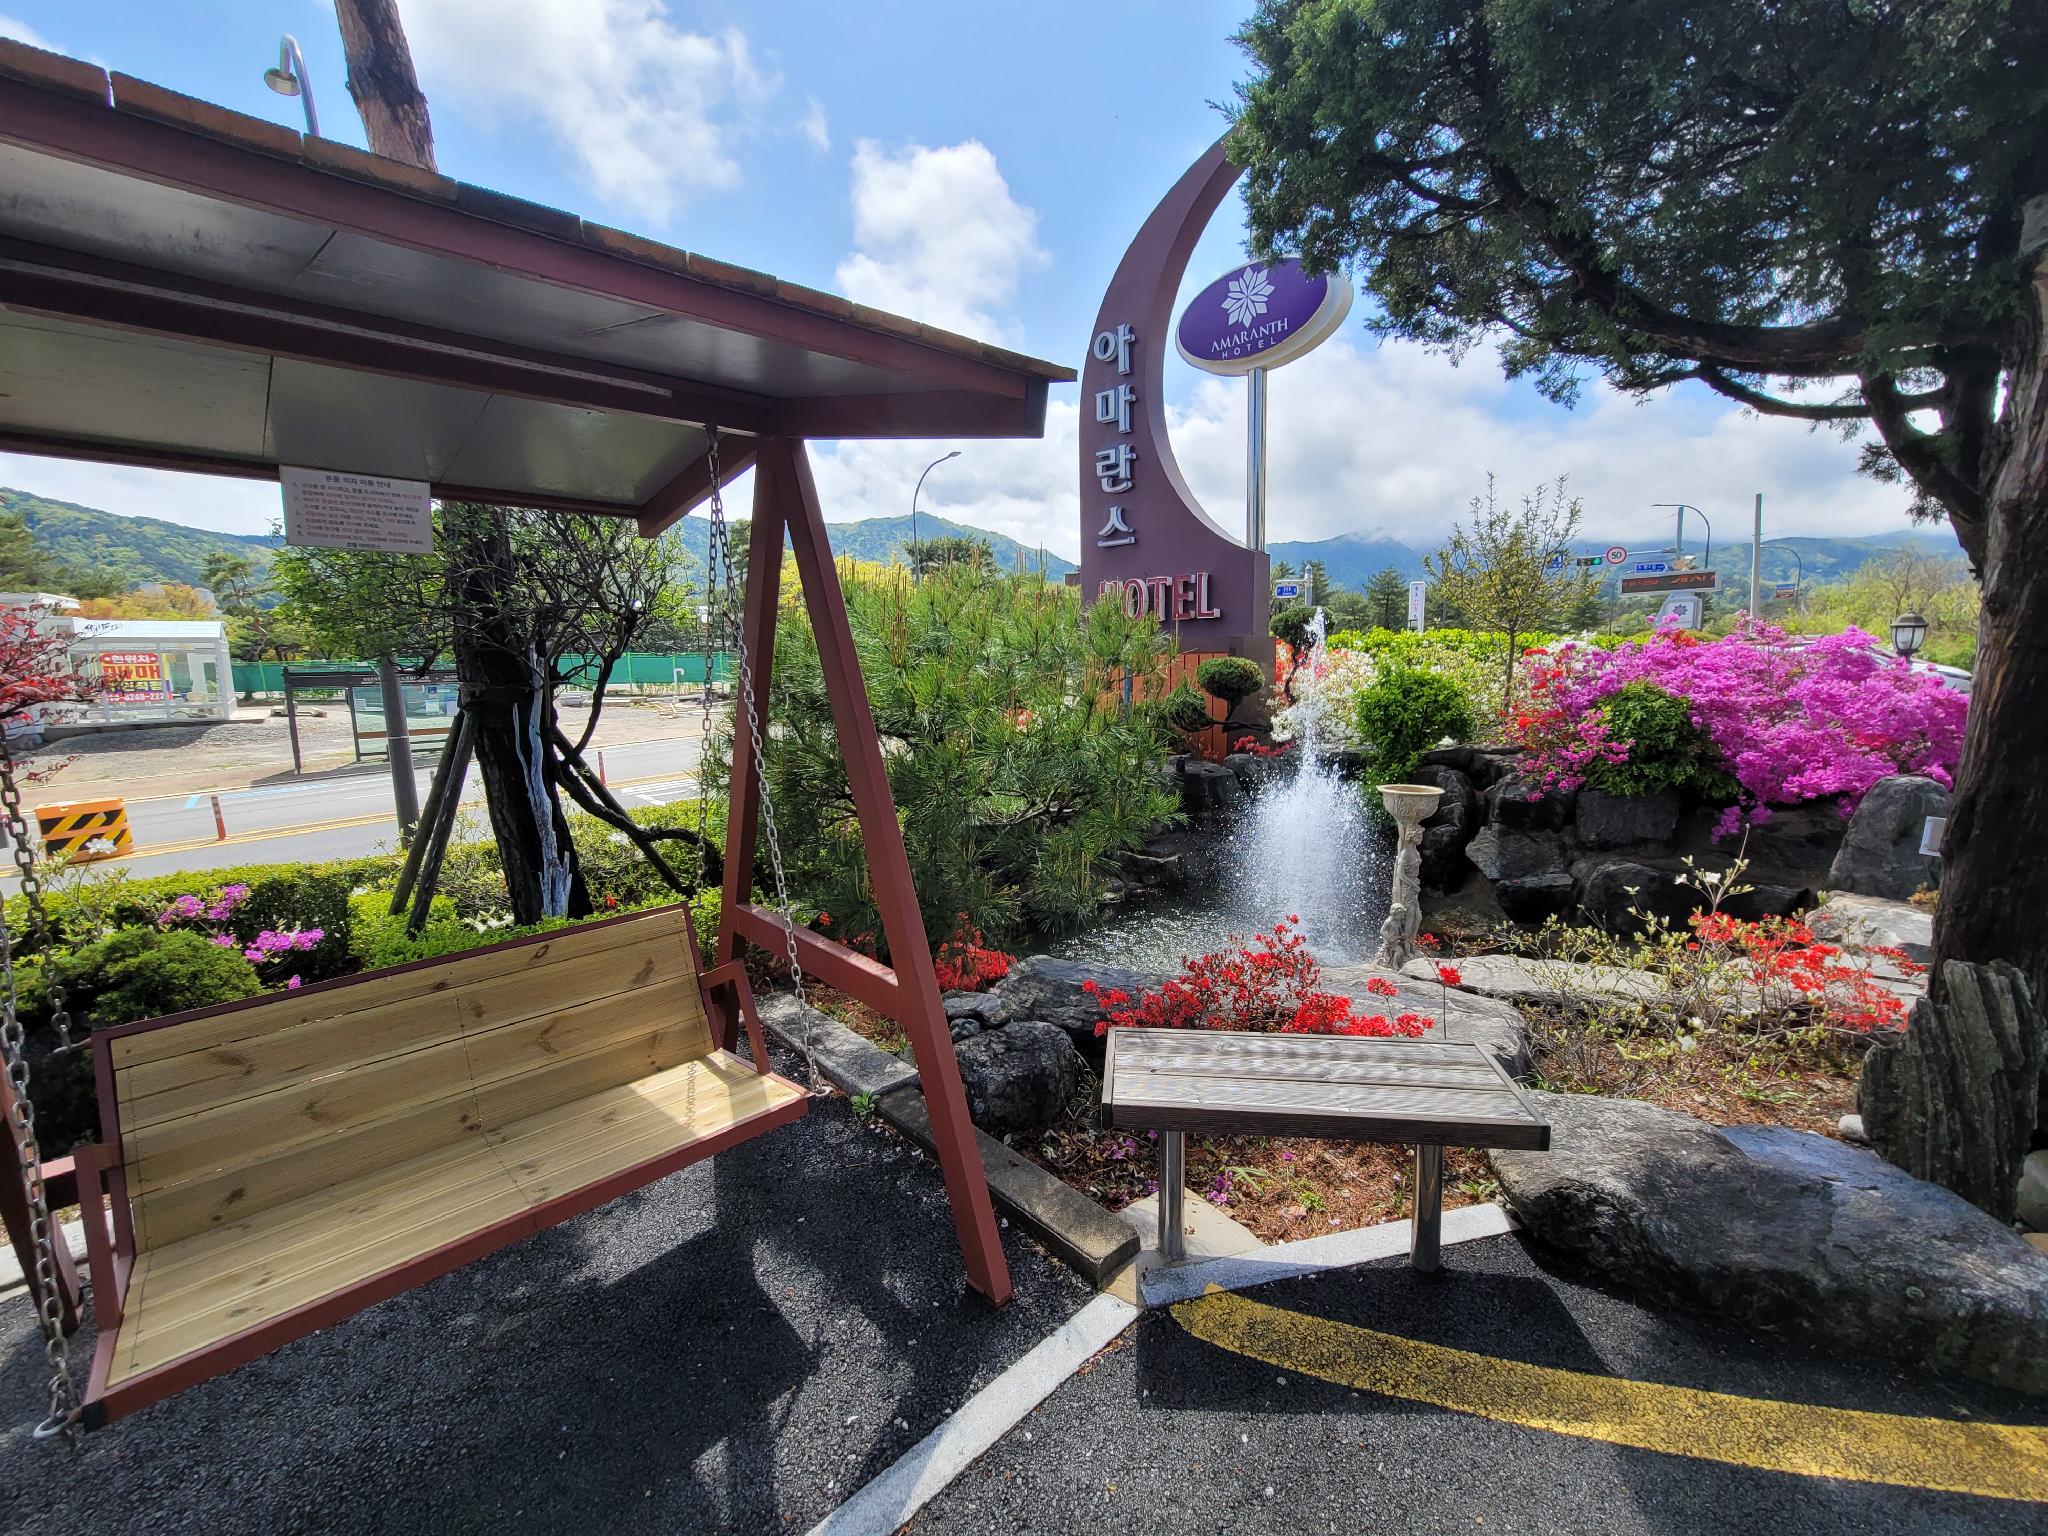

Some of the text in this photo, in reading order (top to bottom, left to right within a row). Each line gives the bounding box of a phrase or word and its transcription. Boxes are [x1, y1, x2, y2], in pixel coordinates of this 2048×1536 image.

[1211, 317, 1288, 353] AMARANTH
[1222, 337, 1276, 359] HOTEL
[1093, 322, 1137, 548] 아마란스
[359, 479, 374, 487] 이용
[376, 480, 391, 489] 안내
[1611, 551, 1622, 560] 50
